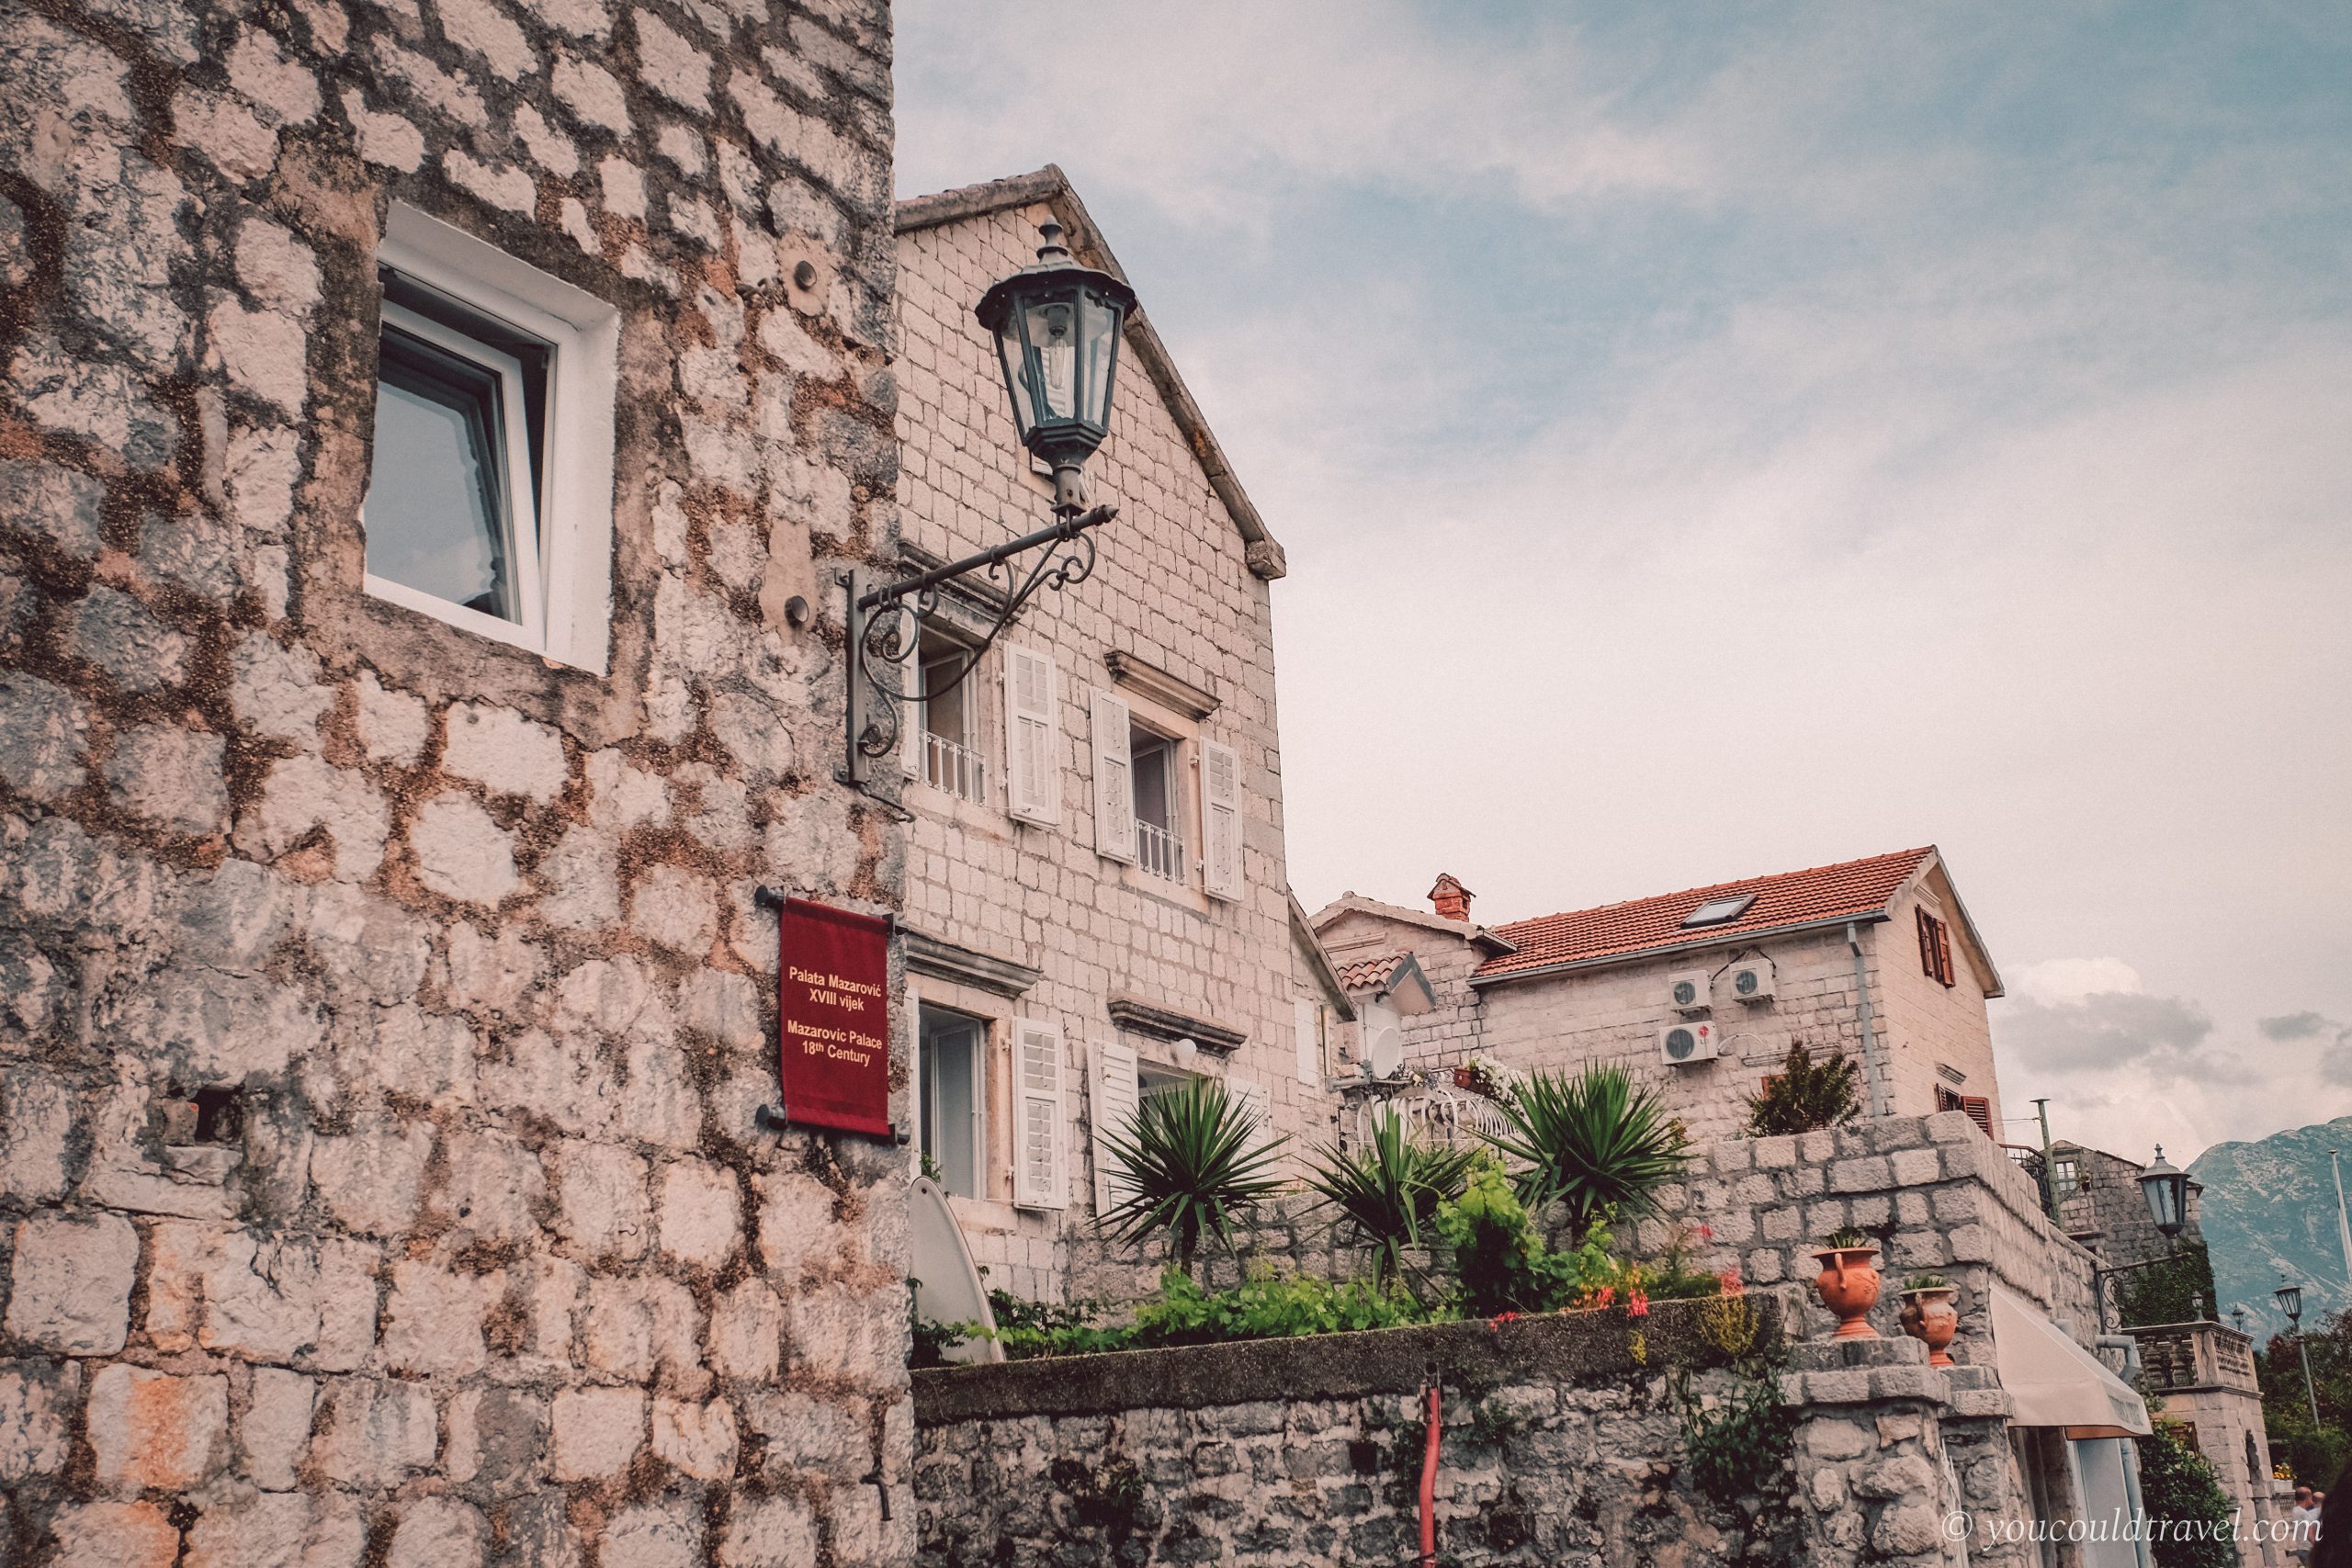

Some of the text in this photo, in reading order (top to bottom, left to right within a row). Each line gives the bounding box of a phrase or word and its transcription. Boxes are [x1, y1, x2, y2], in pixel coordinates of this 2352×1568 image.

[789, 965, 881, 997] Palata Mazarović
[809, 987, 865, 1012] XVIII vijek
[787, 1019, 882, 1049] Mazarovic Palace
[802, 1040, 870, 1066] 18th Century
